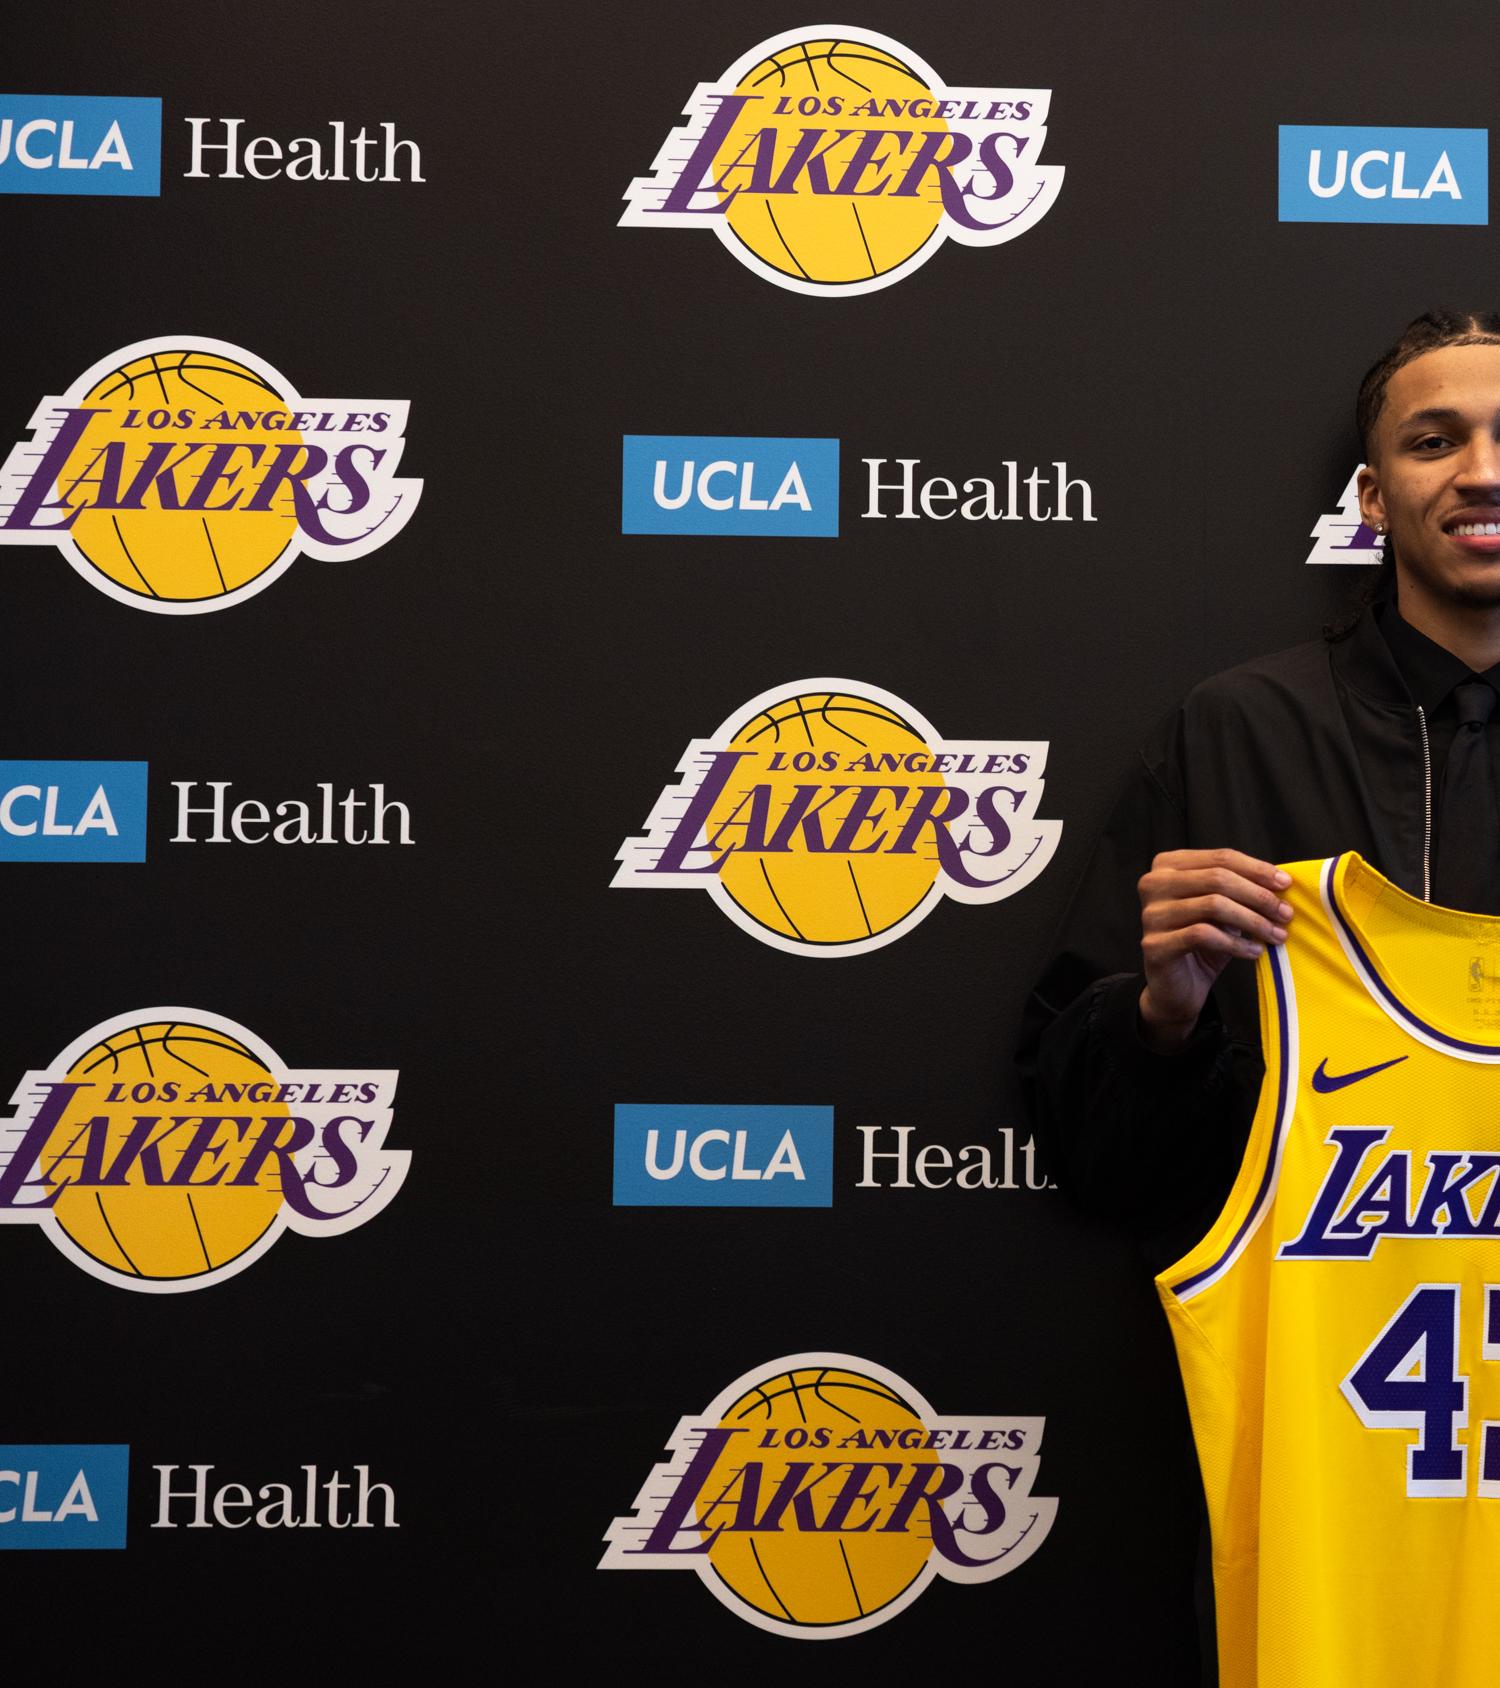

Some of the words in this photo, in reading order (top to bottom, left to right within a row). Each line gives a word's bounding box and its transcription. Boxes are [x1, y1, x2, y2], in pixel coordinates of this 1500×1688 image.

[773, 97, 844, 116] LOS
[849, 98, 1032, 120] ANGELES
[184, 118, 426, 183] Health
[642, 95, 1045, 230] LAKERS
[1308, 149, 1462, 200] UCLA
[121, 409, 195, 429] LOS
[200, 411, 390, 432] ANGELES
[0, 408, 403, 545] LAKERS
[653, 460, 812, 511] UCLA
[861, 459, 1097, 522] Health
[767, 752, 840, 772] LOS
[844, 753, 1030, 774] ANGELES
[0, 785, 118, 836] CLA
[169, 781, 415, 845] Health
[634, 751, 1043, 888] LAKERS
[104, 1082, 181, 1103] LOS
[184, 1082, 379, 1103] ANGELES
[0, 1081, 391, 1220] LAKERS
[645, 1129, 805, 1180] UCLA
[856, 1126, 1058, 1189] Healt
[758, 1428, 833, 1449] LOS
[836, 1428, 1026, 1450] ANGELES
[151, 1464, 400, 1529] Health
[623, 1428, 1037, 1567] LAKERS
